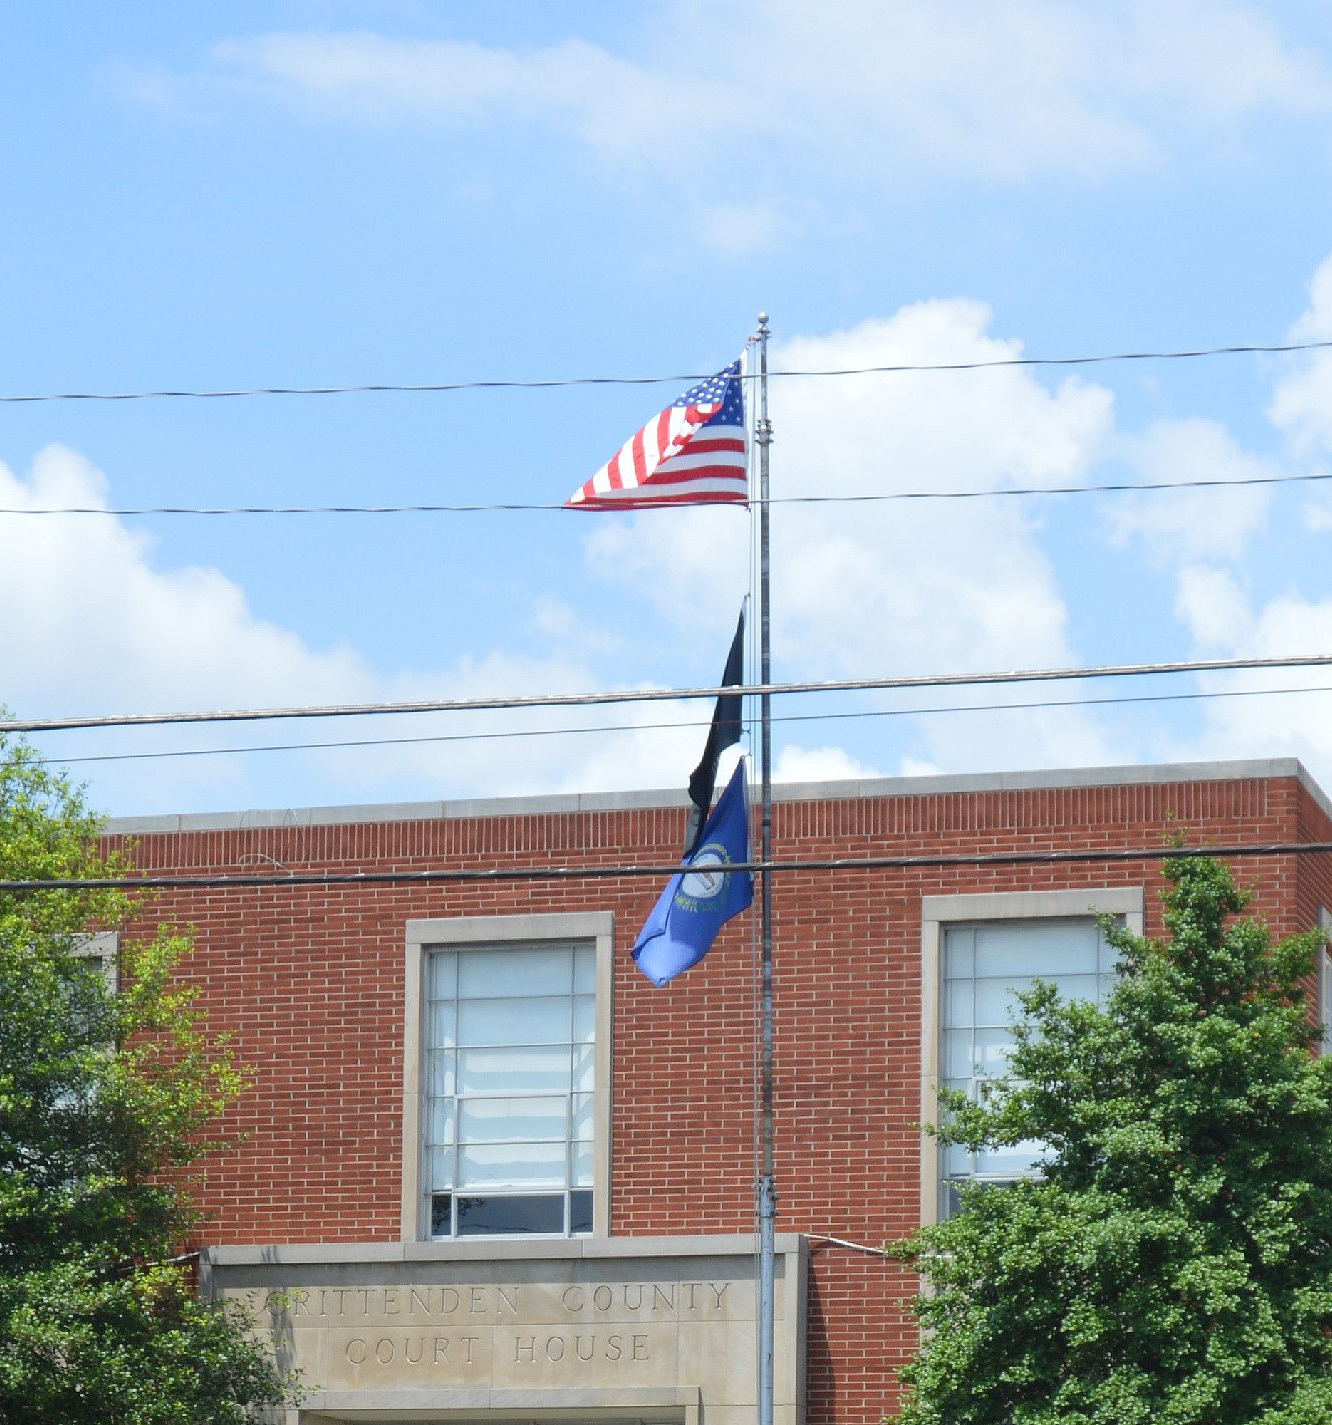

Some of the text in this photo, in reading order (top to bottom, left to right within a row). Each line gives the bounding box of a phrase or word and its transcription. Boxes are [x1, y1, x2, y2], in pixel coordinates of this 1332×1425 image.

[265, 1282, 732, 1317] CRITTENDEN COUNTY
[345, 1334, 651, 1365] COURT HOUSE
